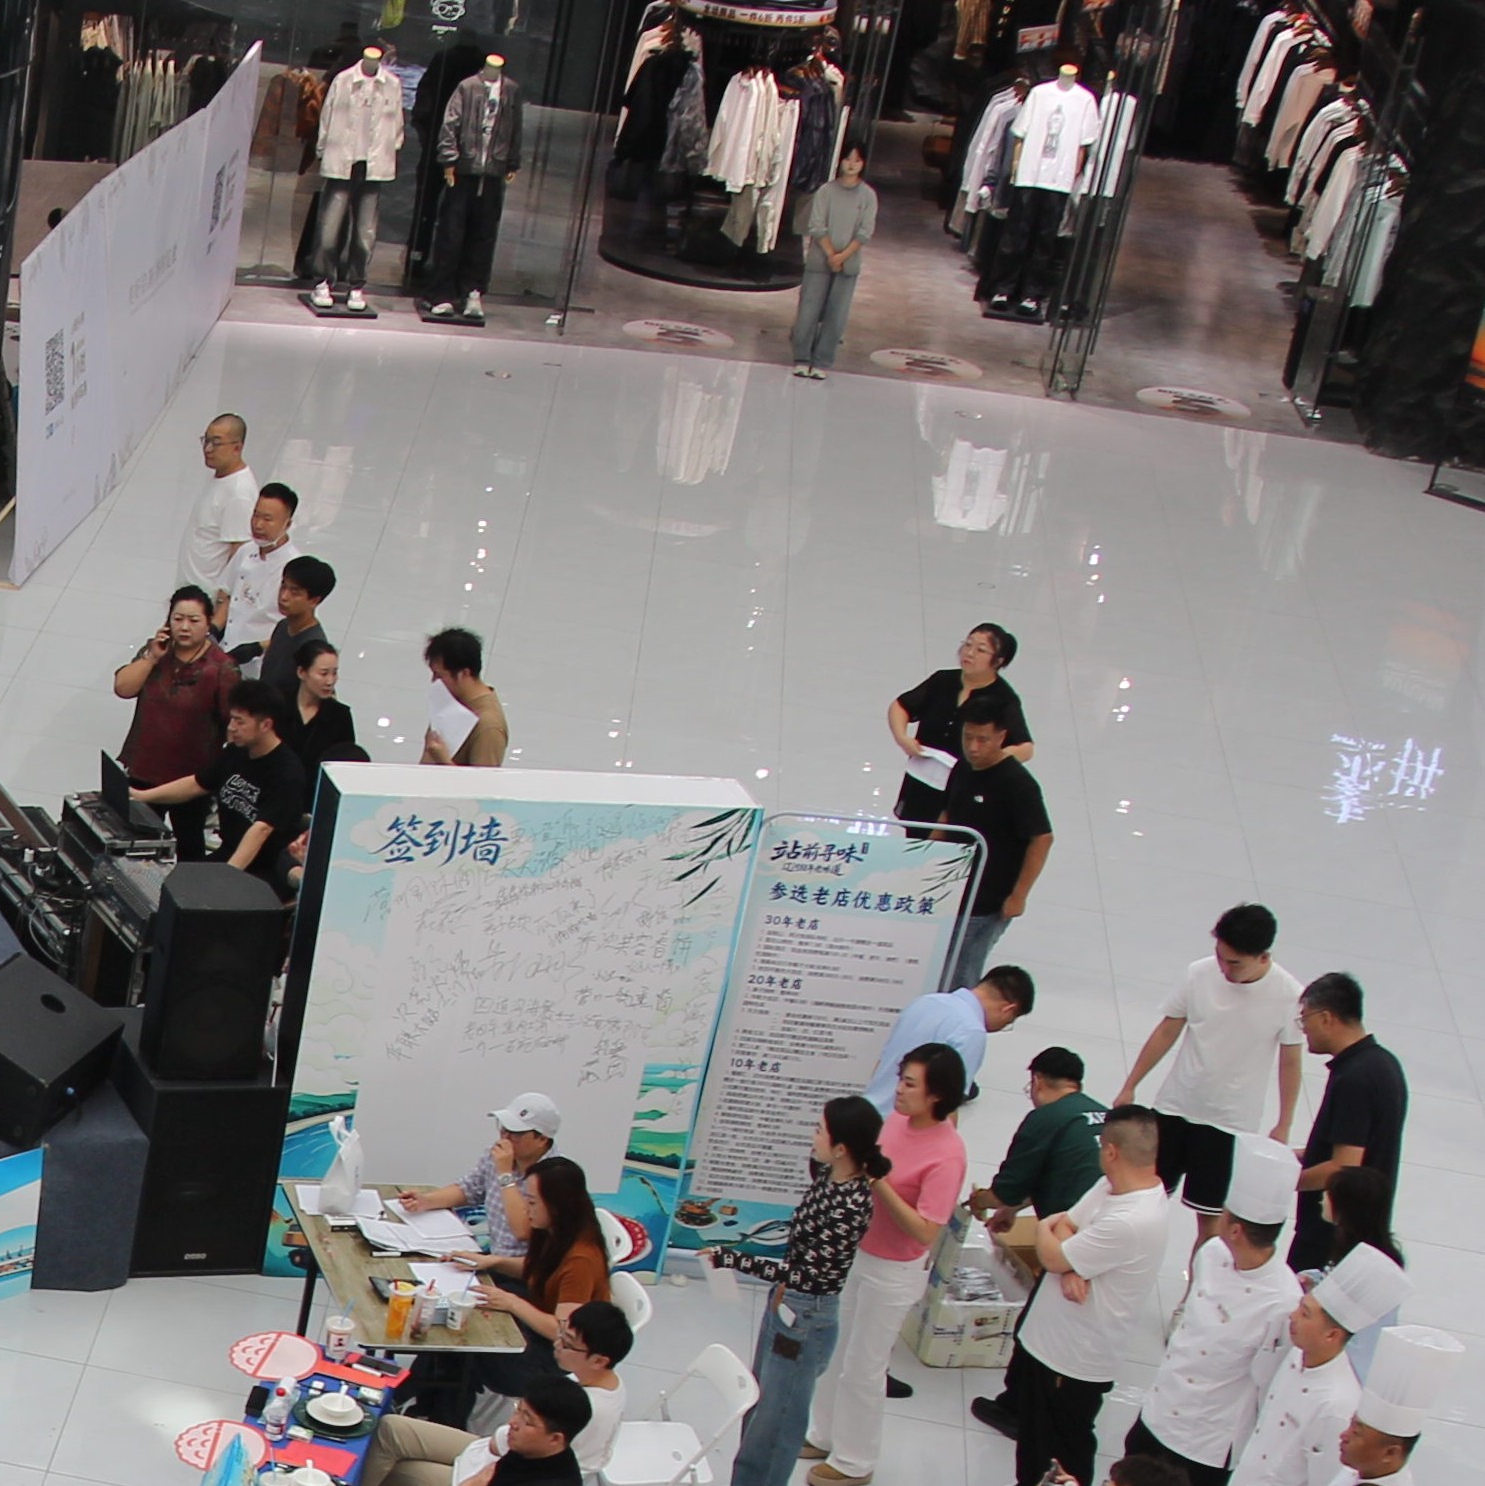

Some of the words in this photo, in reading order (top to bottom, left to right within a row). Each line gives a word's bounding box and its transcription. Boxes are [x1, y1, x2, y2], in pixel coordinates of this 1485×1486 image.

[371, 814, 510, 866] 签到墙
[770, 840, 864, 864] 站前寻味
[769, 881, 937, 915] 参选老店优惠政策
[765, 915, 820, 931] 30年老店
[748, 974, 804, 990] 20年老店
[730, 1058, 782, 1073] 10年老店
